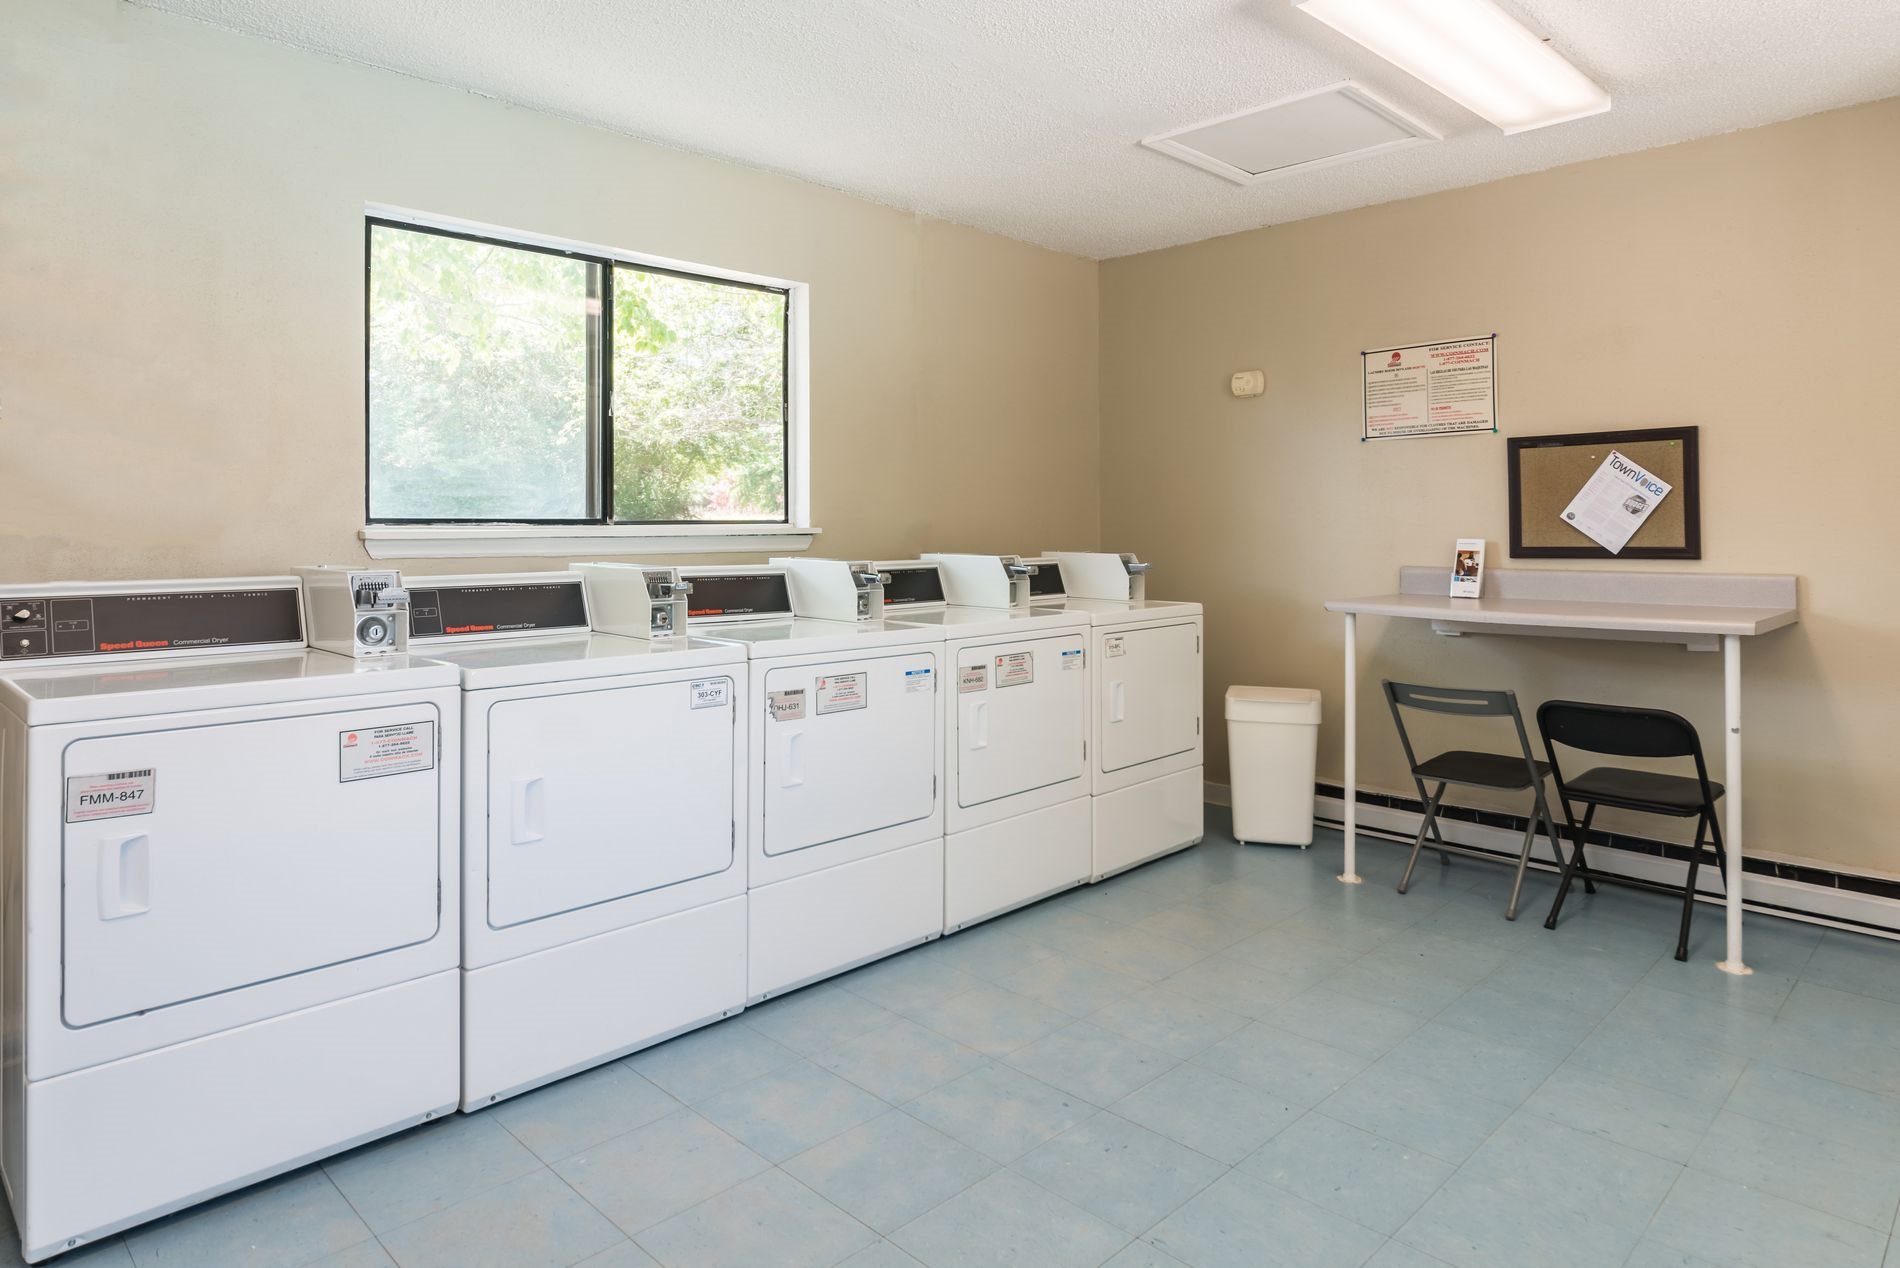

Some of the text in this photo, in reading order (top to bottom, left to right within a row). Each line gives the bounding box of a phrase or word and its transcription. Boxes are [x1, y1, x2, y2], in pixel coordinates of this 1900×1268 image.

[1609, 455, 1664, 496] TownVoice
[100, 640, 134, 651] Speed
[135, 640, 168, 648] Queen
[173, 637, 211, 645] Commercial
[80, 790, 144, 806] FMM-847
